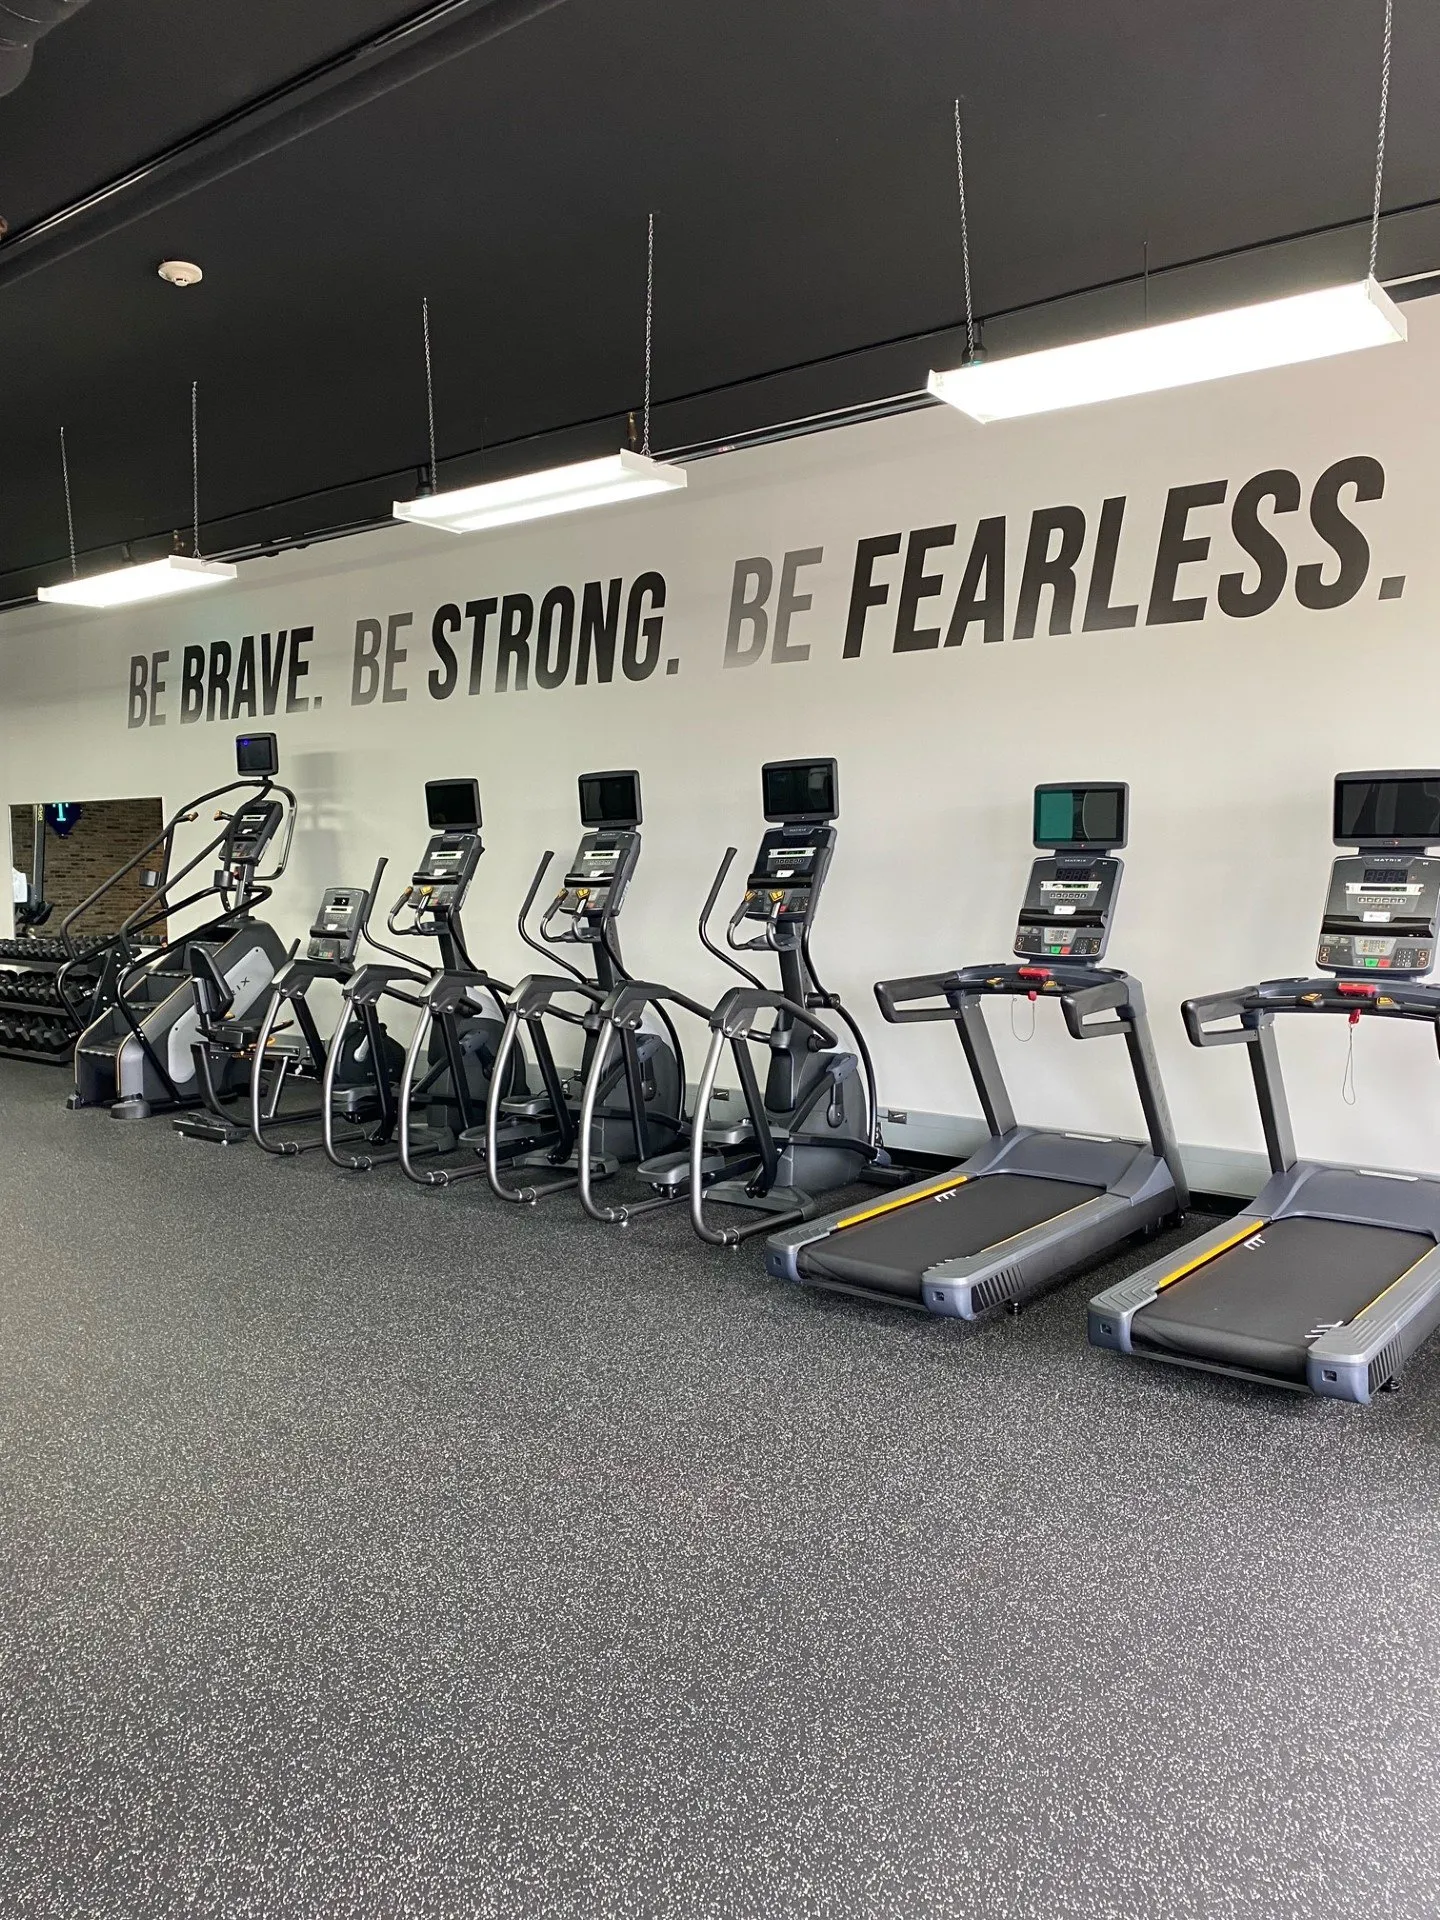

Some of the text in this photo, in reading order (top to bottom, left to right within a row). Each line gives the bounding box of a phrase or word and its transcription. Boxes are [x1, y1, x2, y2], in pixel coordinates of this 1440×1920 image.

[127, 456, 1407, 729] BE BRAVE. BE STRONG. BE FEARLESS.
